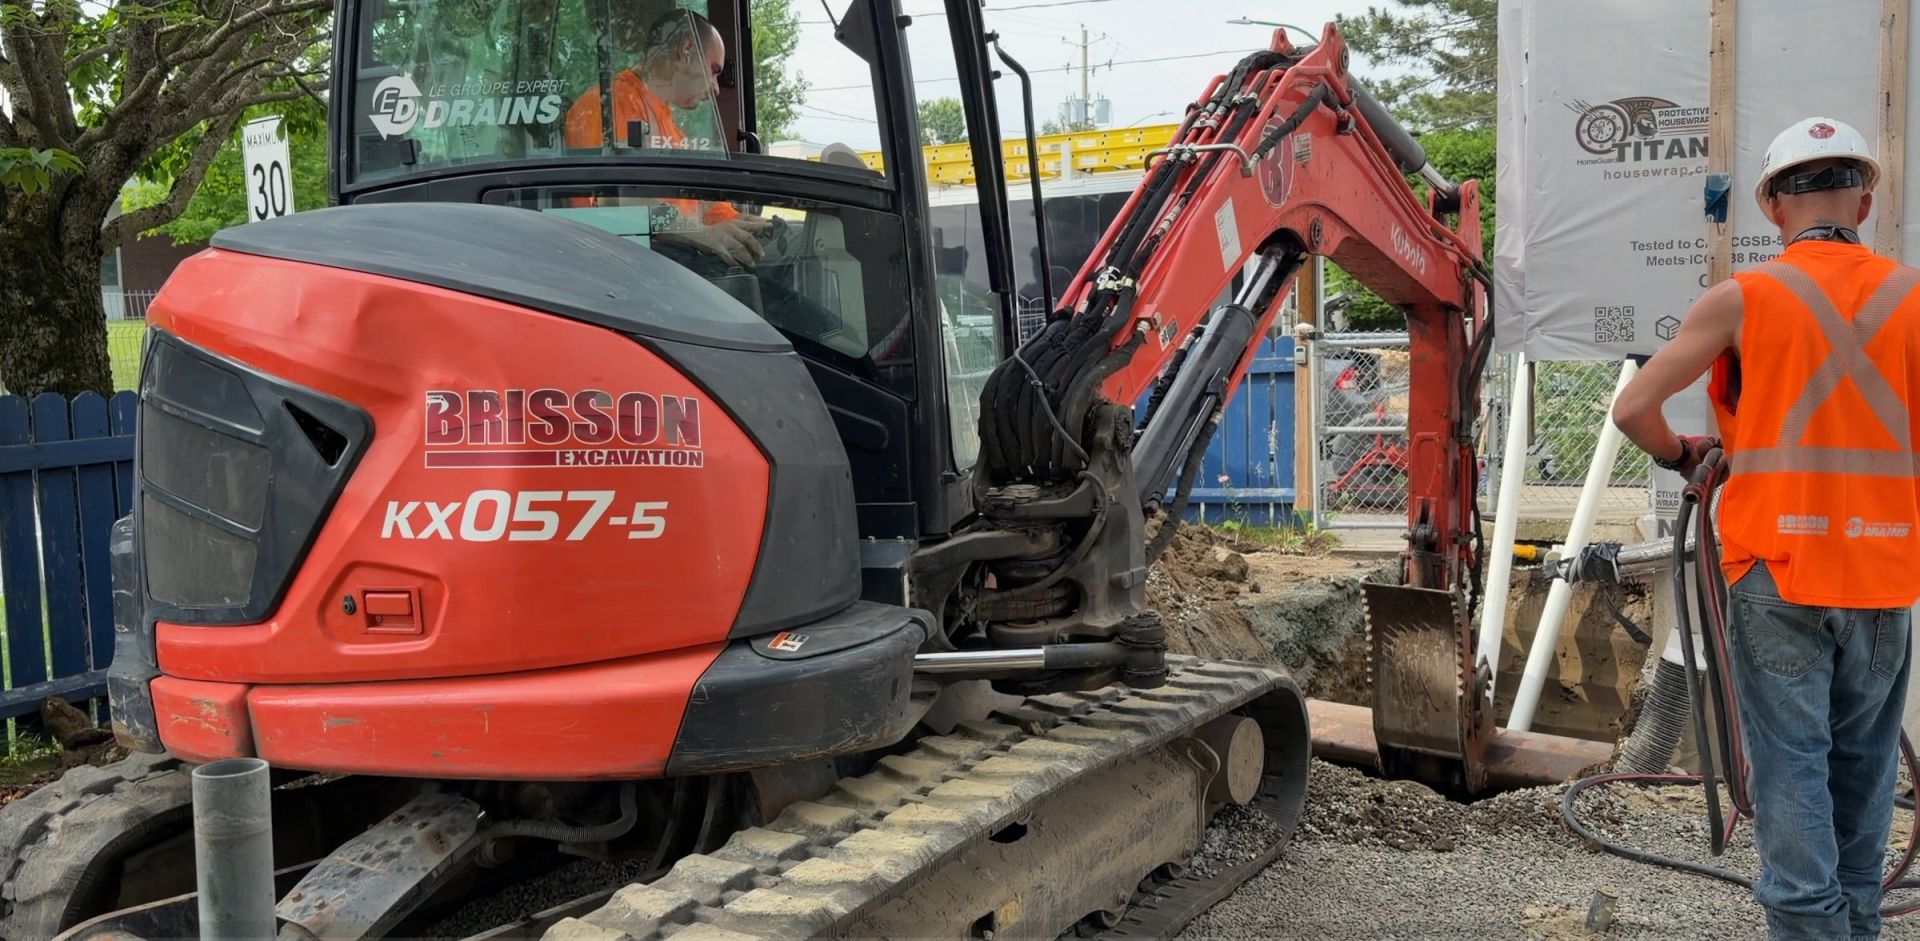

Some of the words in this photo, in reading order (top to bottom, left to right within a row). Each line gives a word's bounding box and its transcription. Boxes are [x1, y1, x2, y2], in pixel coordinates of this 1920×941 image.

[429, 84, 446, 98] LE
[450, 82, 511, 97] GROUPE
[516, 79, 566, 94] EXPERT
[423, 94, 562, 129] DRAINS
[1658, 107, 1709, 118] PROTECTIVE
[246, 131, 283, 149] MAXIMU
[651, 135, 710, 150] EX-412
[1612, 136, 1709, 163] TITAN
[1577, 158, 1617, 166] HomeGuard
[253, 160, 286, 221] 30
[1390, 222, 1425, 275] Kubota
[1631, 239, 1674, 252] Tested
[1678, 239, 1691, 249] to
[1646, 255, 1685, 266] Meets
[424, 388, 701, 449] BRISSON
[561, 450, 703, 468] EXCAVATION
[380, 489, 669, 542] KX057-5
